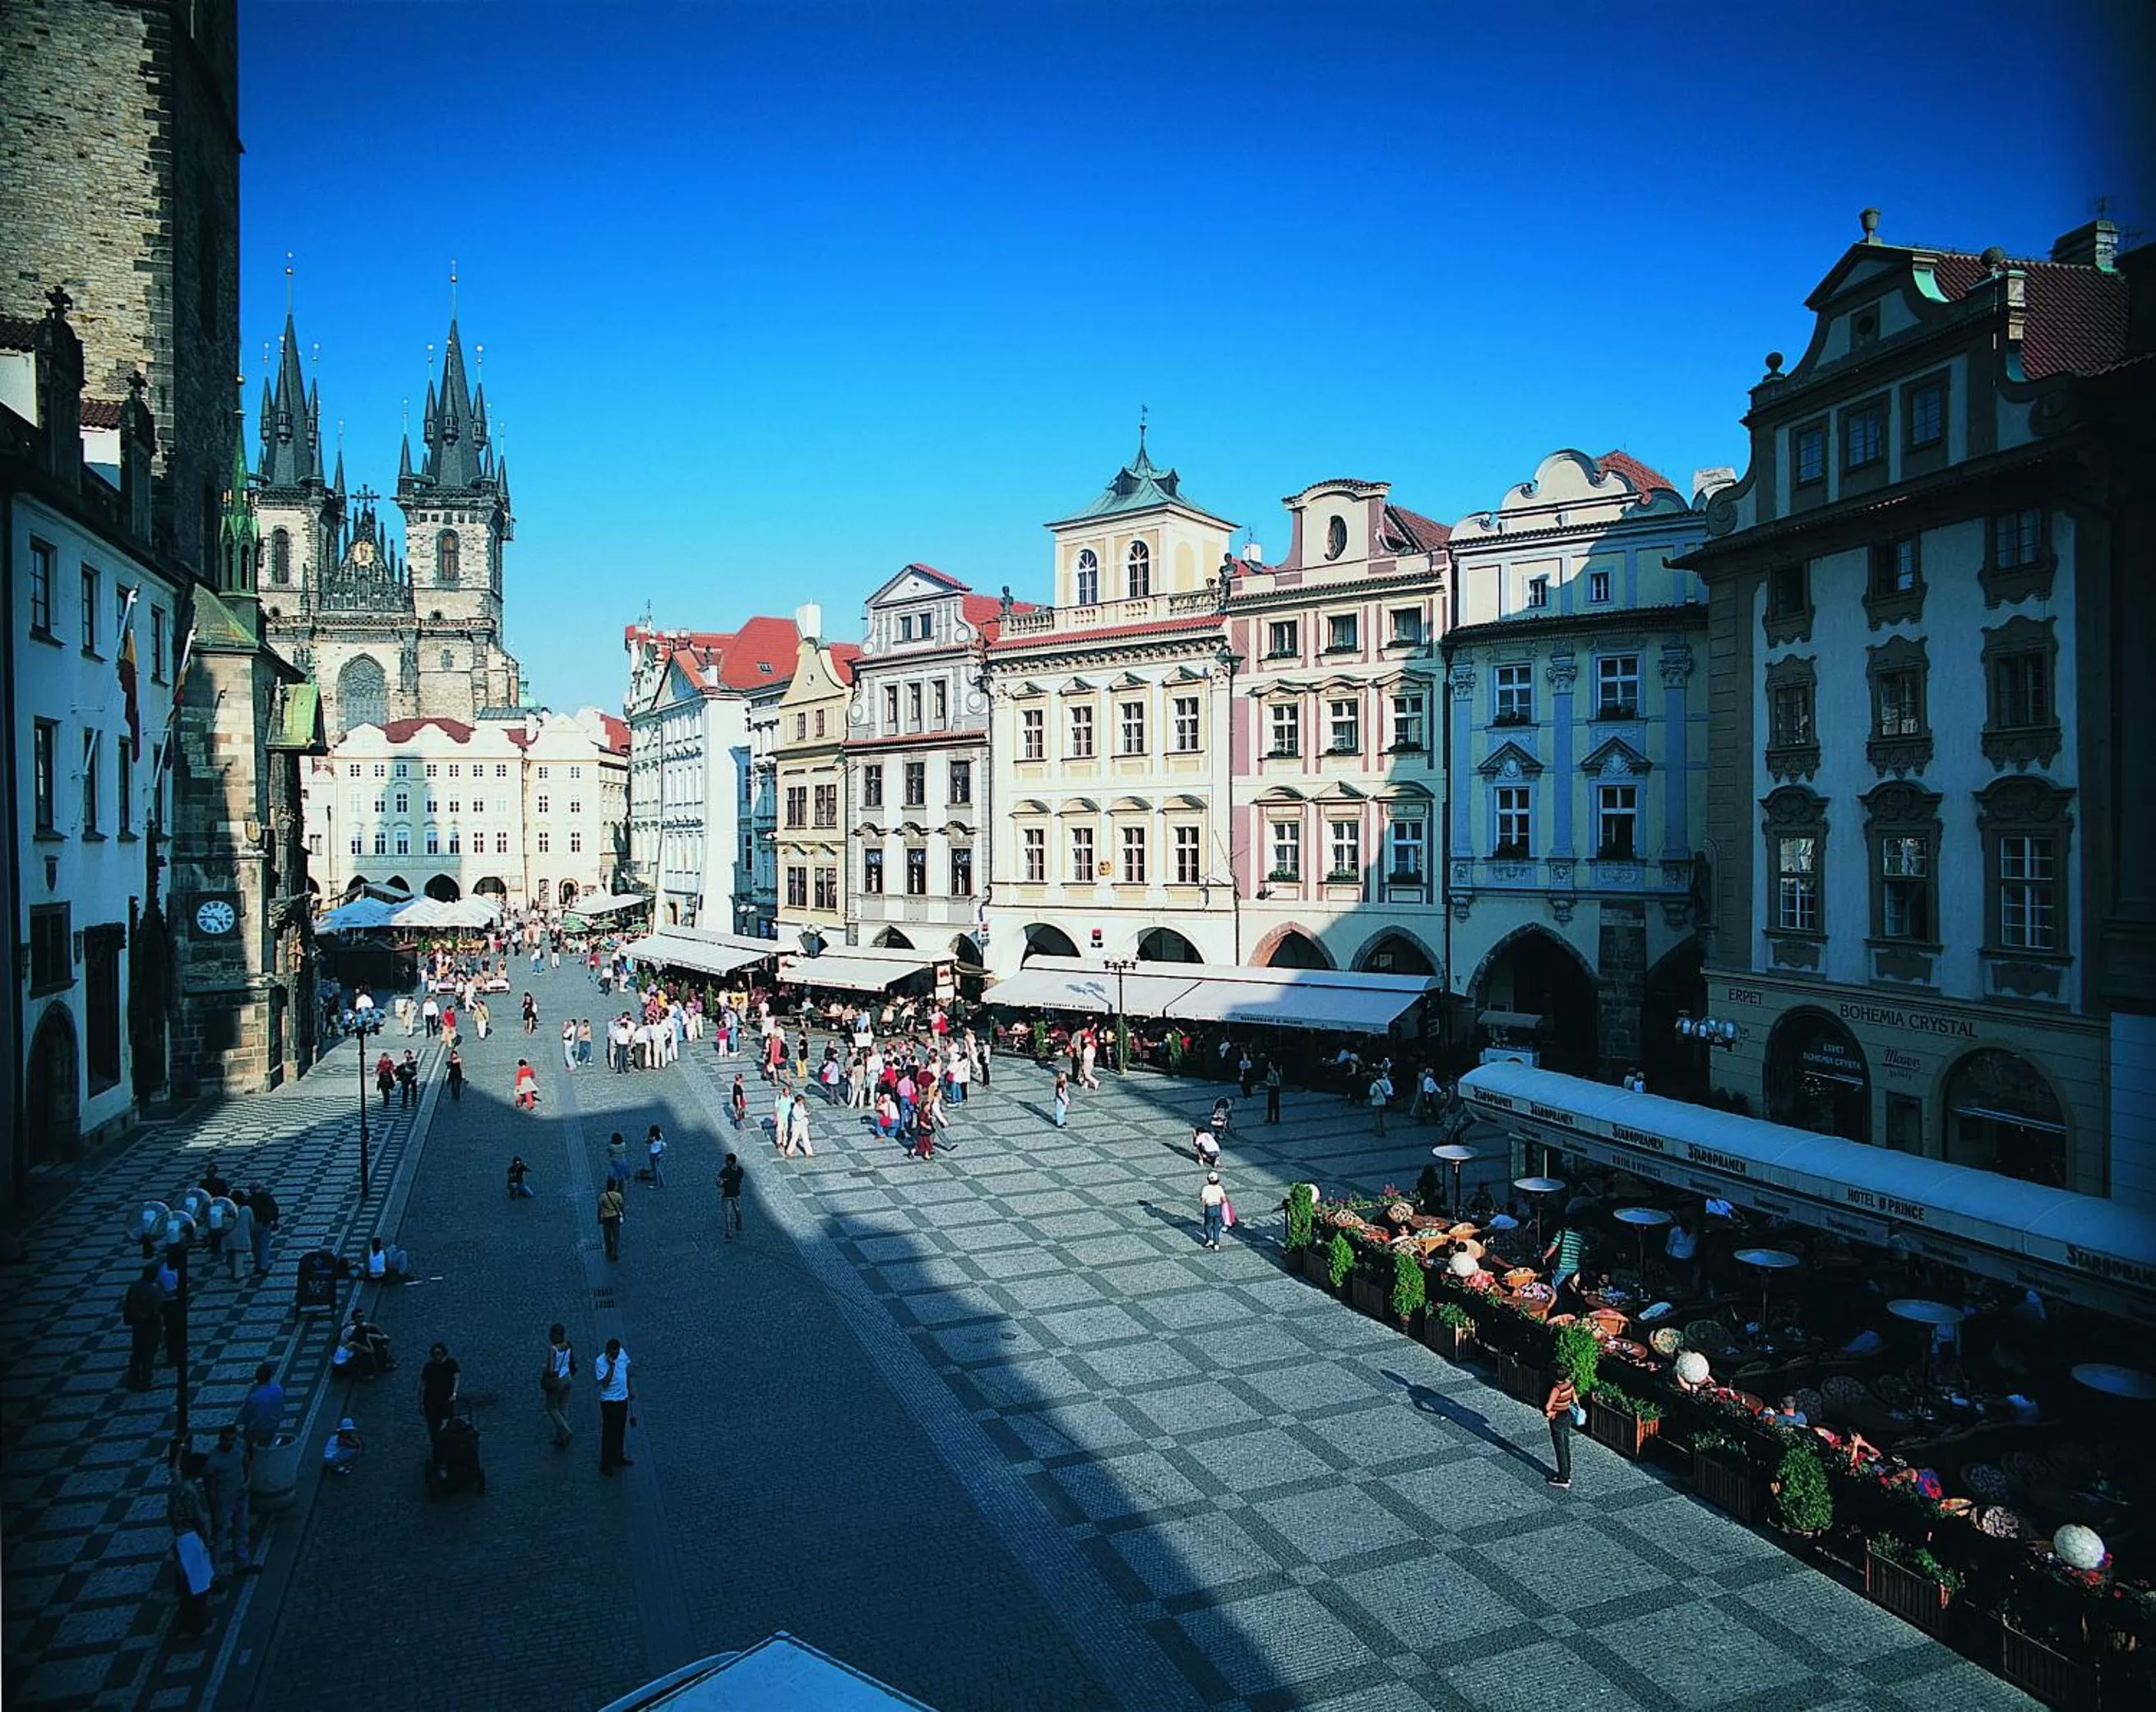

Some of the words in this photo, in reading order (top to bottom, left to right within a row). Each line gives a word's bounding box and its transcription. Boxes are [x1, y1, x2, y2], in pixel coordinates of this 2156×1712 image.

[1728, 988, 1763, 1005] ERPET
[1840, 1004, 1904, 1026] BOHEMIA
[1908, 1015, 1978, 1038] CRYSTAL
[1612, 1123, 1663, 1151] STAROPRAMEN
[1688, 1143, 1746, 1173] STAROPRAMEN
[1848, 1187, 1875, 1207] HOTEL
[1879, 1197, 1885, 1210] U
[1888, 1201, 1925, 1221] PRINCE
